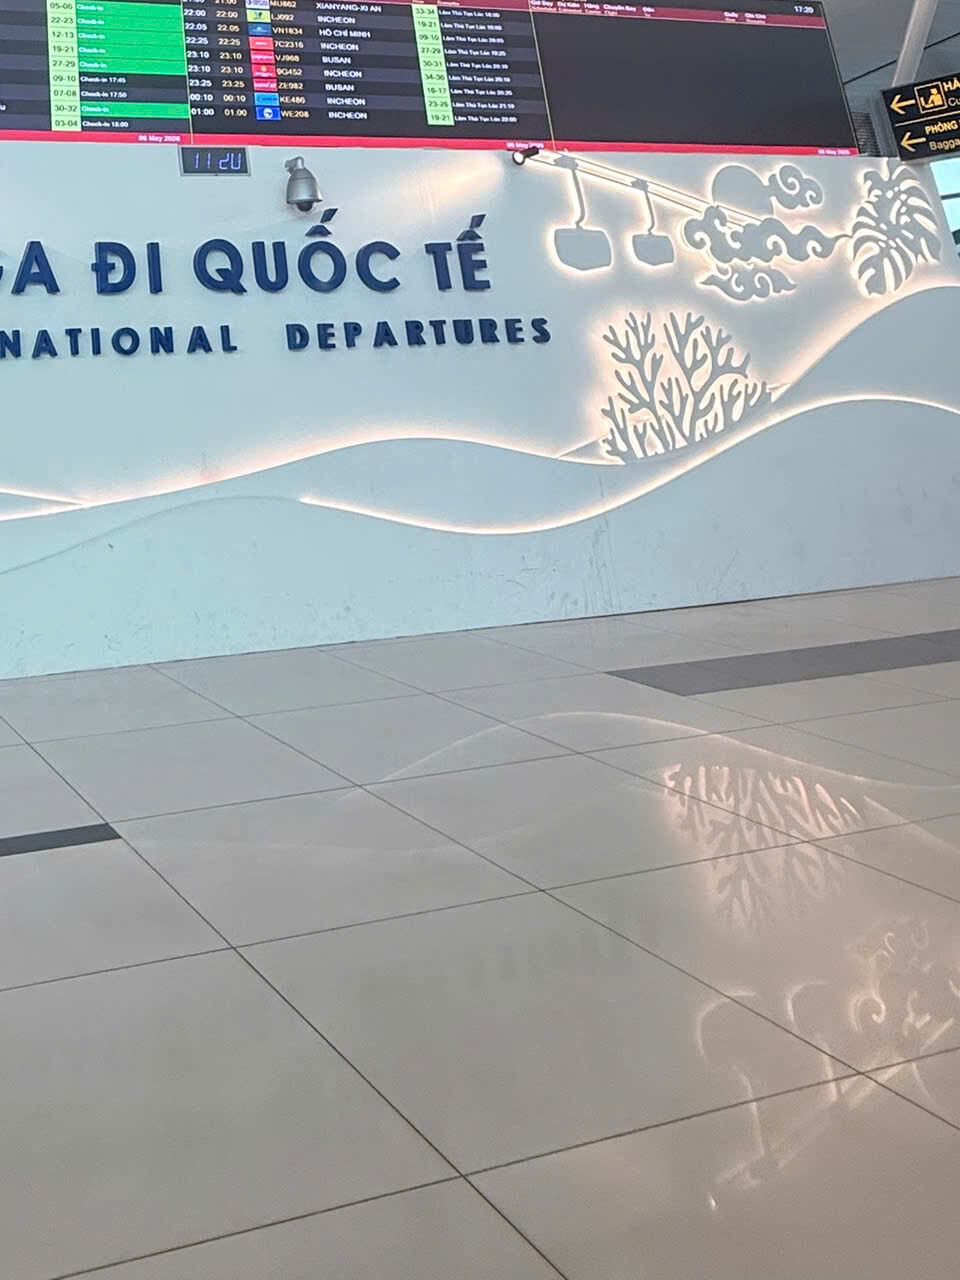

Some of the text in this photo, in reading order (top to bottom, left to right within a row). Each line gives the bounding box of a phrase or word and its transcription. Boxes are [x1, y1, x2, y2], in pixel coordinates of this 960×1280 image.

[188, 65, 211, 73] 23:10
[925, 120, 958, 135] PHÒNG
[91, 241, 162, 294] ĐI
[193, 208, 401, 295] QUỐC
[424, 214, 491, 291] TẾ
[286, 318, 552, 351] DEPARTURES
